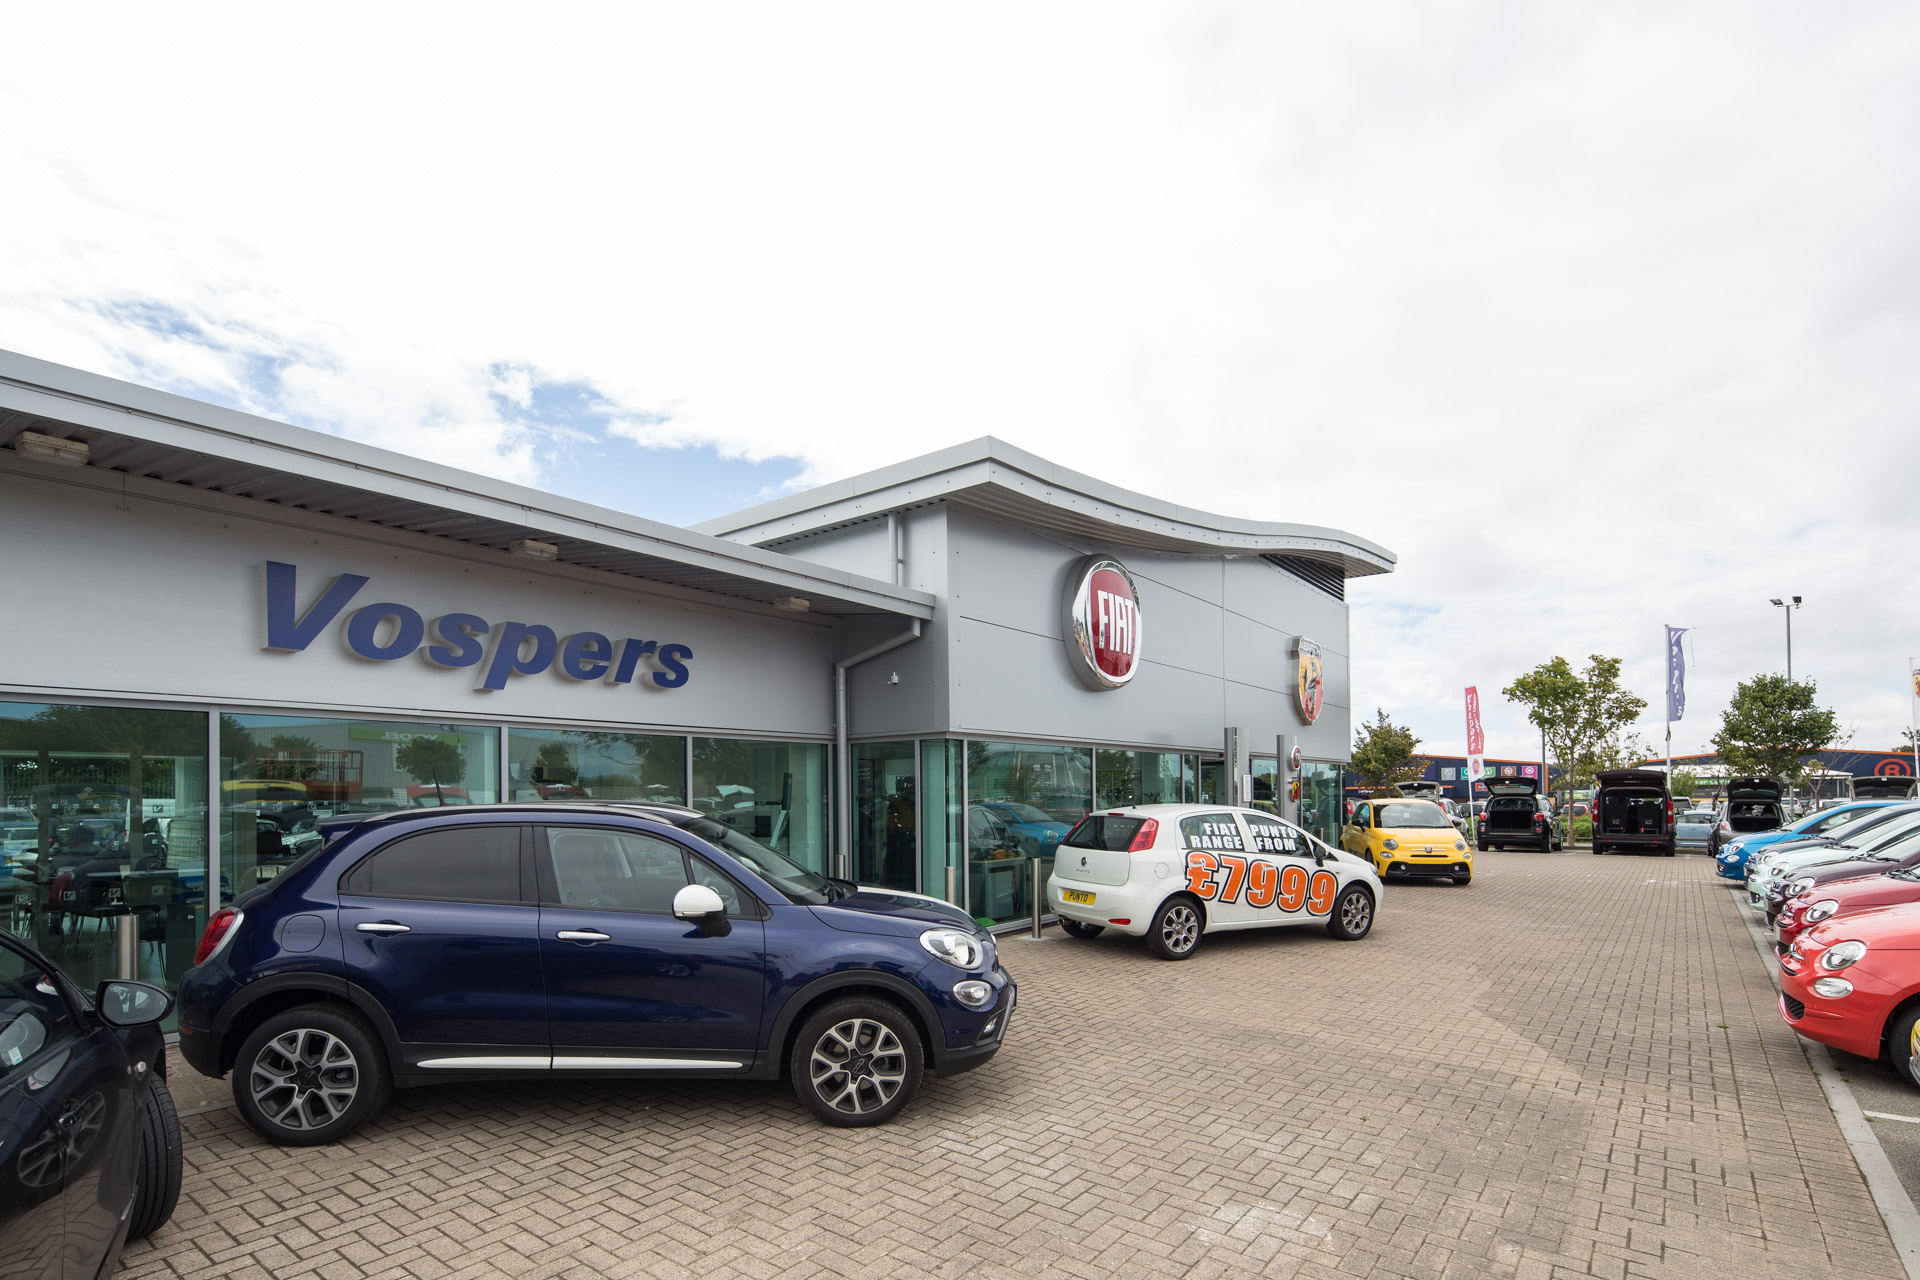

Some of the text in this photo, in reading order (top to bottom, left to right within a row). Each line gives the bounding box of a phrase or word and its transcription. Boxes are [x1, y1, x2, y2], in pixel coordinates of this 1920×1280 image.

[261, 560, 693, 691] Vospers
[1098, 589, 1133, 655] FIAT
[1670, 630, 1684, 717] Vops
[1190, 835, 1297, 851] RANGE FROM
[1203, 823, 1298, 839] FIAT PUNTO
[1069, 891, 1089, 903] PUNTO
[1185, 851, 1338, 917] £7999
